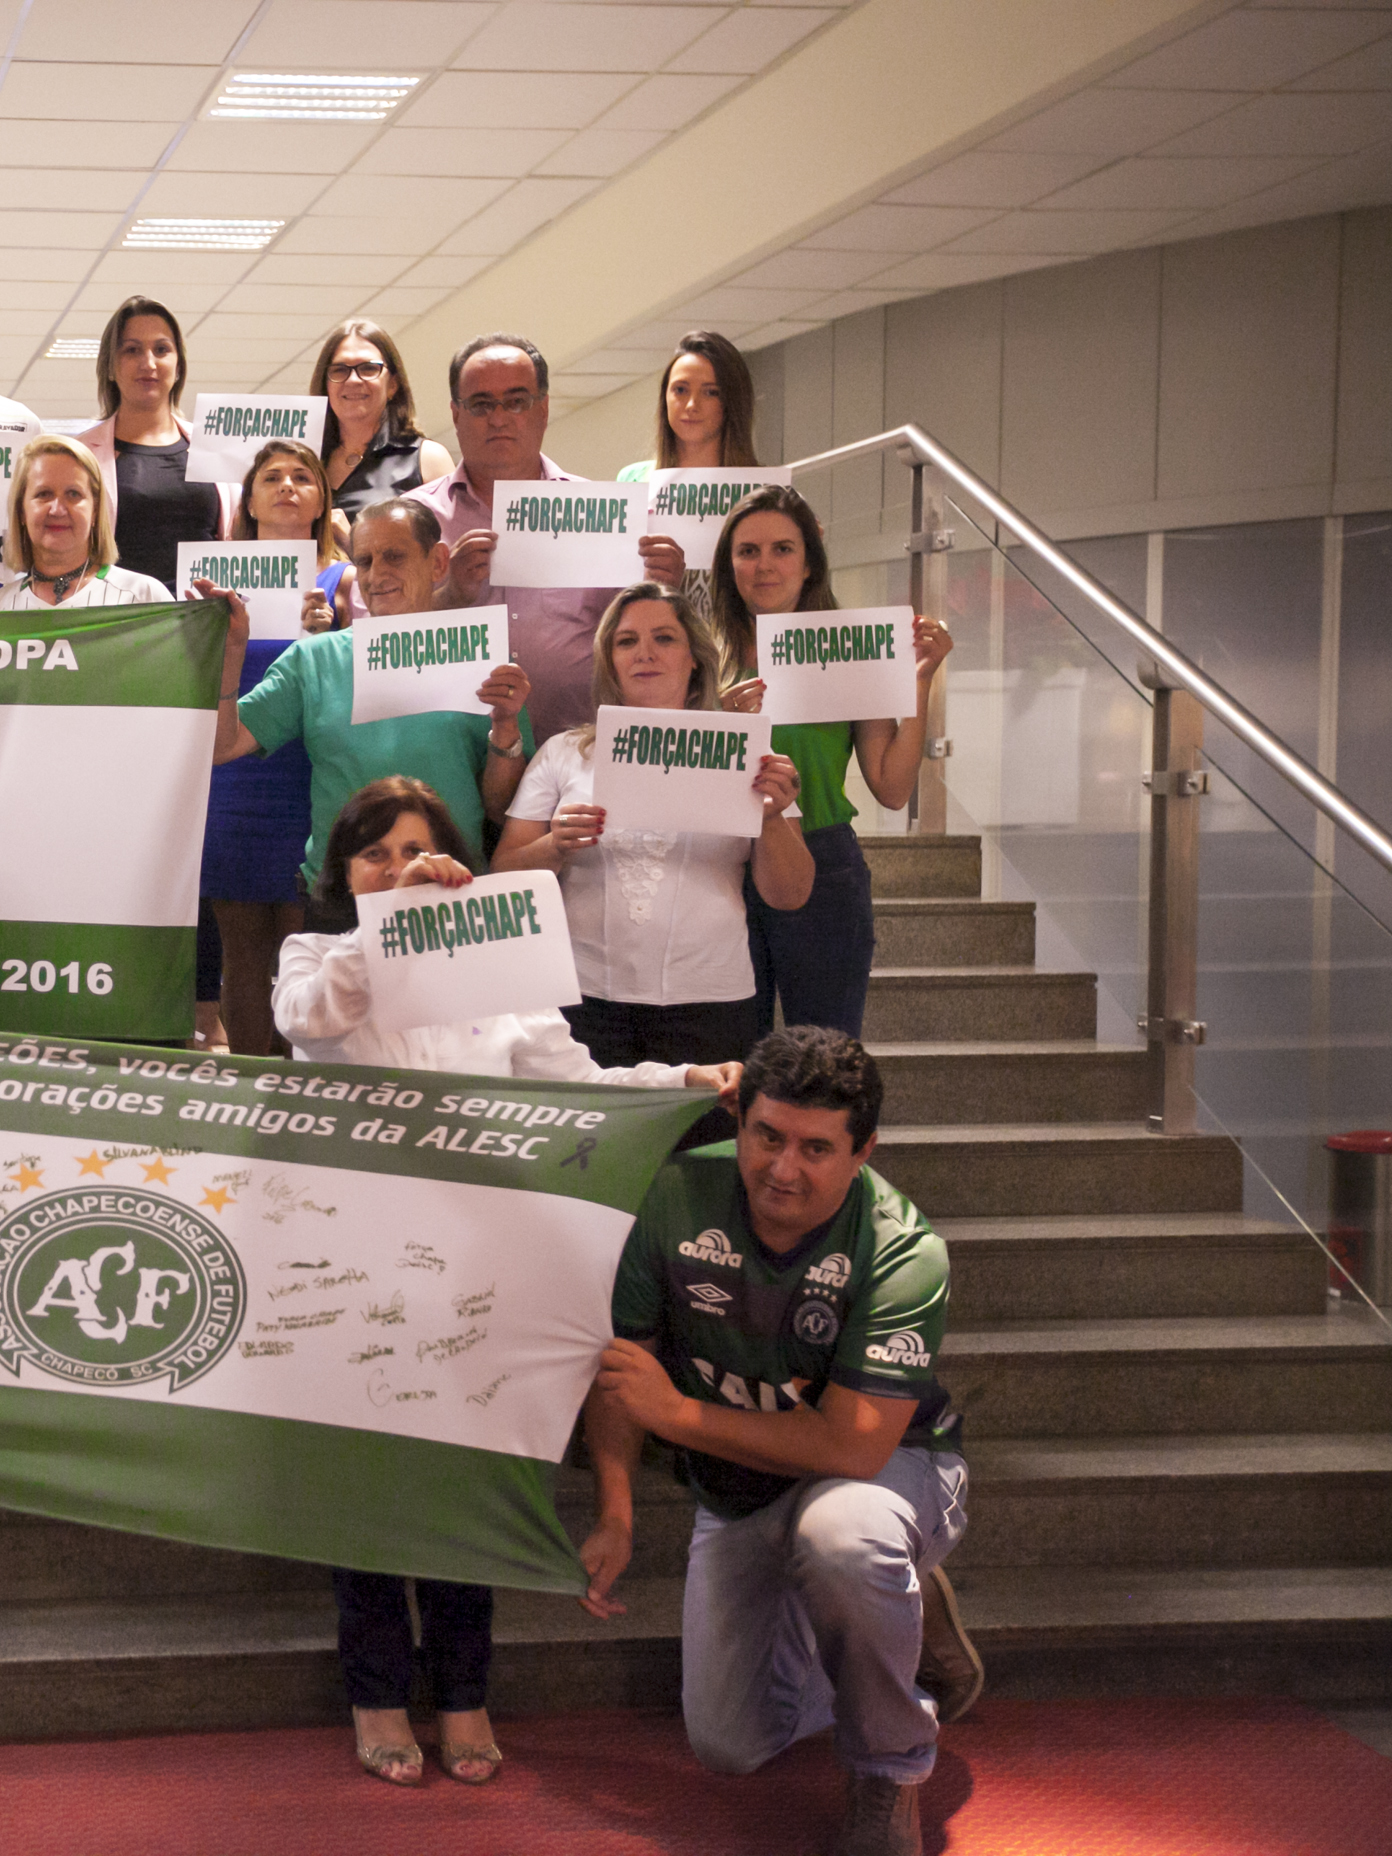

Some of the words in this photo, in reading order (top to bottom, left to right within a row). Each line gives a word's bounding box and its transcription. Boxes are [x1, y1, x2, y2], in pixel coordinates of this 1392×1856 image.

[204, 407, 308, 442] #FORÇACHAPE
[506, 497, 627, 539] #FORÇACHAPE
[367, 624, 490, 674] #FORÇACHAPE
[771, 624, 895, 670] #FORÇACHAPE
[612, 725, 748, 775] #FORÇACHAPE
[380, 889, 541, 958] #FORÇACHAPE
[1, 960, 114, 996] 2016
[118, 1056, 239, 1088] vocês
[253, 1073, 424, 1110] estarão
[434, 1093, 607, 1130] sempre
[179, 1097, 338, 1136] amigos
[351, 1116, 409, 1145] da
[416, 1125, 551, 1160] ALESC
[29, 1195, 214, 1252] CHAPECOENSE
[202, 1250, 231, 1281] DE
[678, 1240, 744, 1268] aurora
[173, 1283, 234, 1372] FUTEBOL
[130, 1362, 154, 1378] SC
[865, 1343, 931, 1367] aurora
